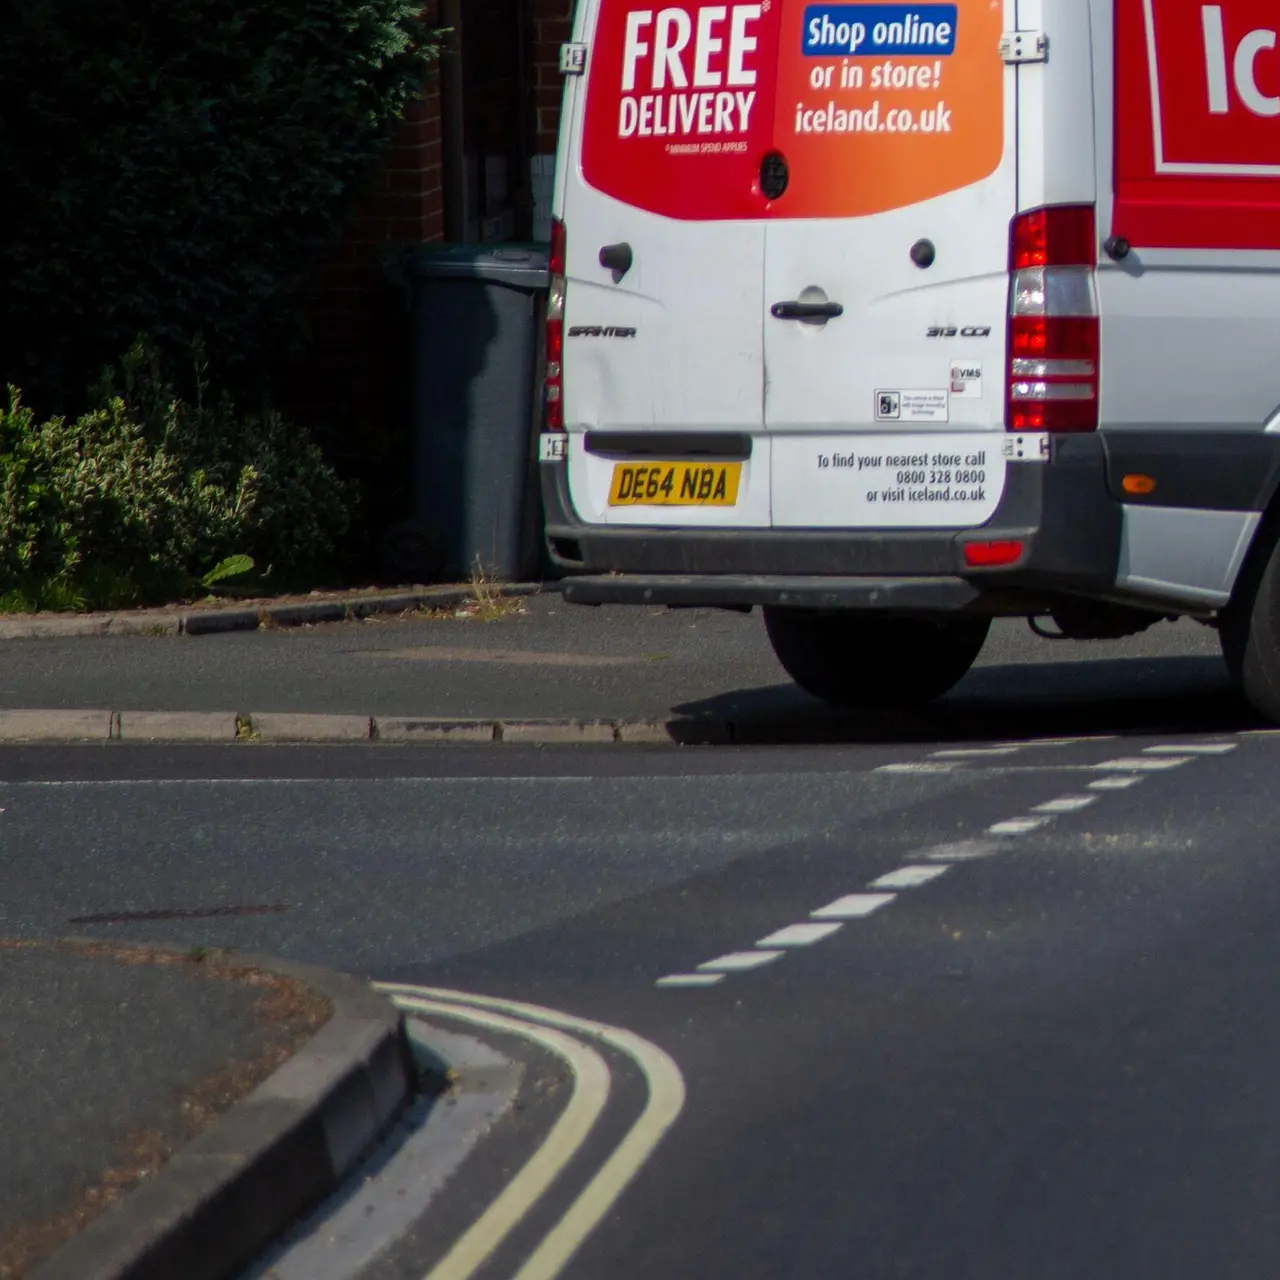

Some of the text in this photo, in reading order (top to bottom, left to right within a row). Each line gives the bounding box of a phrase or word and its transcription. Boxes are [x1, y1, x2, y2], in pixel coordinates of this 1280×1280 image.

[621, 4, 761, 93] FREE
[808, 14, 951, 53] Shop online
[810, 58, 942, 89] or in store!
[618, 91, 756, 138] DELIVERY
[795, 100, 952, 134] iceland.co.uk
[568, 325, 637, 337] SPRINTER
[926, 326, 991, 337] 313 CDI
[817, 451, 986, 470] To find your nearest store call
[618, 467, 726, 499] DE64 NBA
[896, 470, 986, 484] 0800 328 0800
[866, 486, 986, 502] or visit iceland.co.uk
